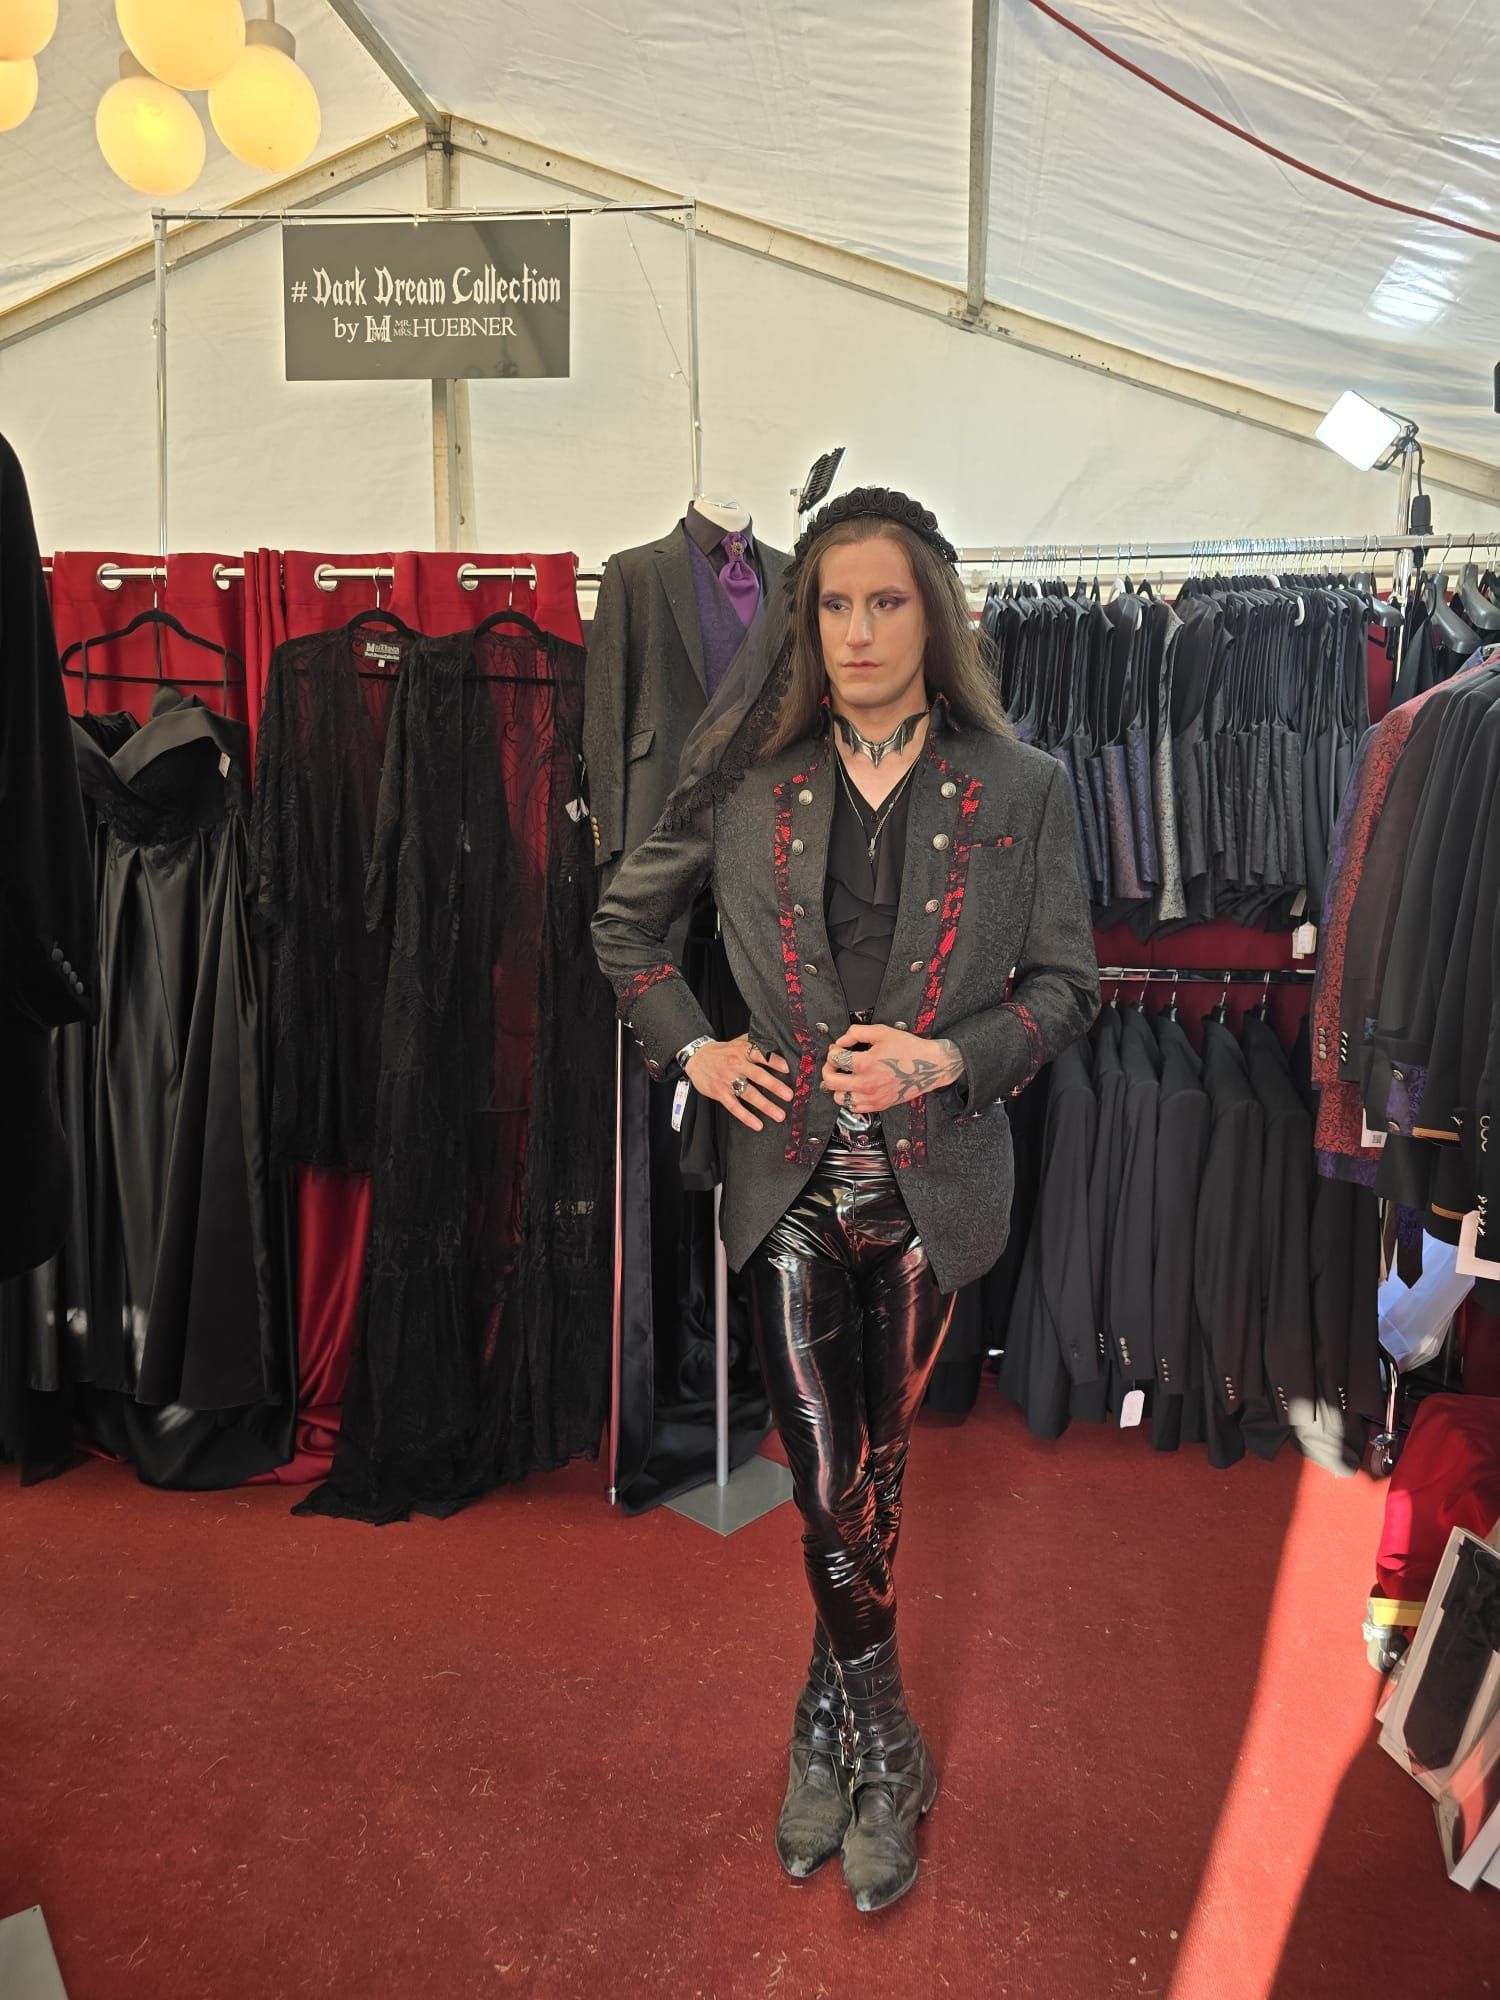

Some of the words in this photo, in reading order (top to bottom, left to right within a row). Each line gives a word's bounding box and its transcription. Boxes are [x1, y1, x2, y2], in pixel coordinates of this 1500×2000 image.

[373, 265, 445, 307] Dream
[452, 263, 560, 305] Collection
[333, 316, 360, 343] by
[413, 317, 517, 337] HUEBNER
